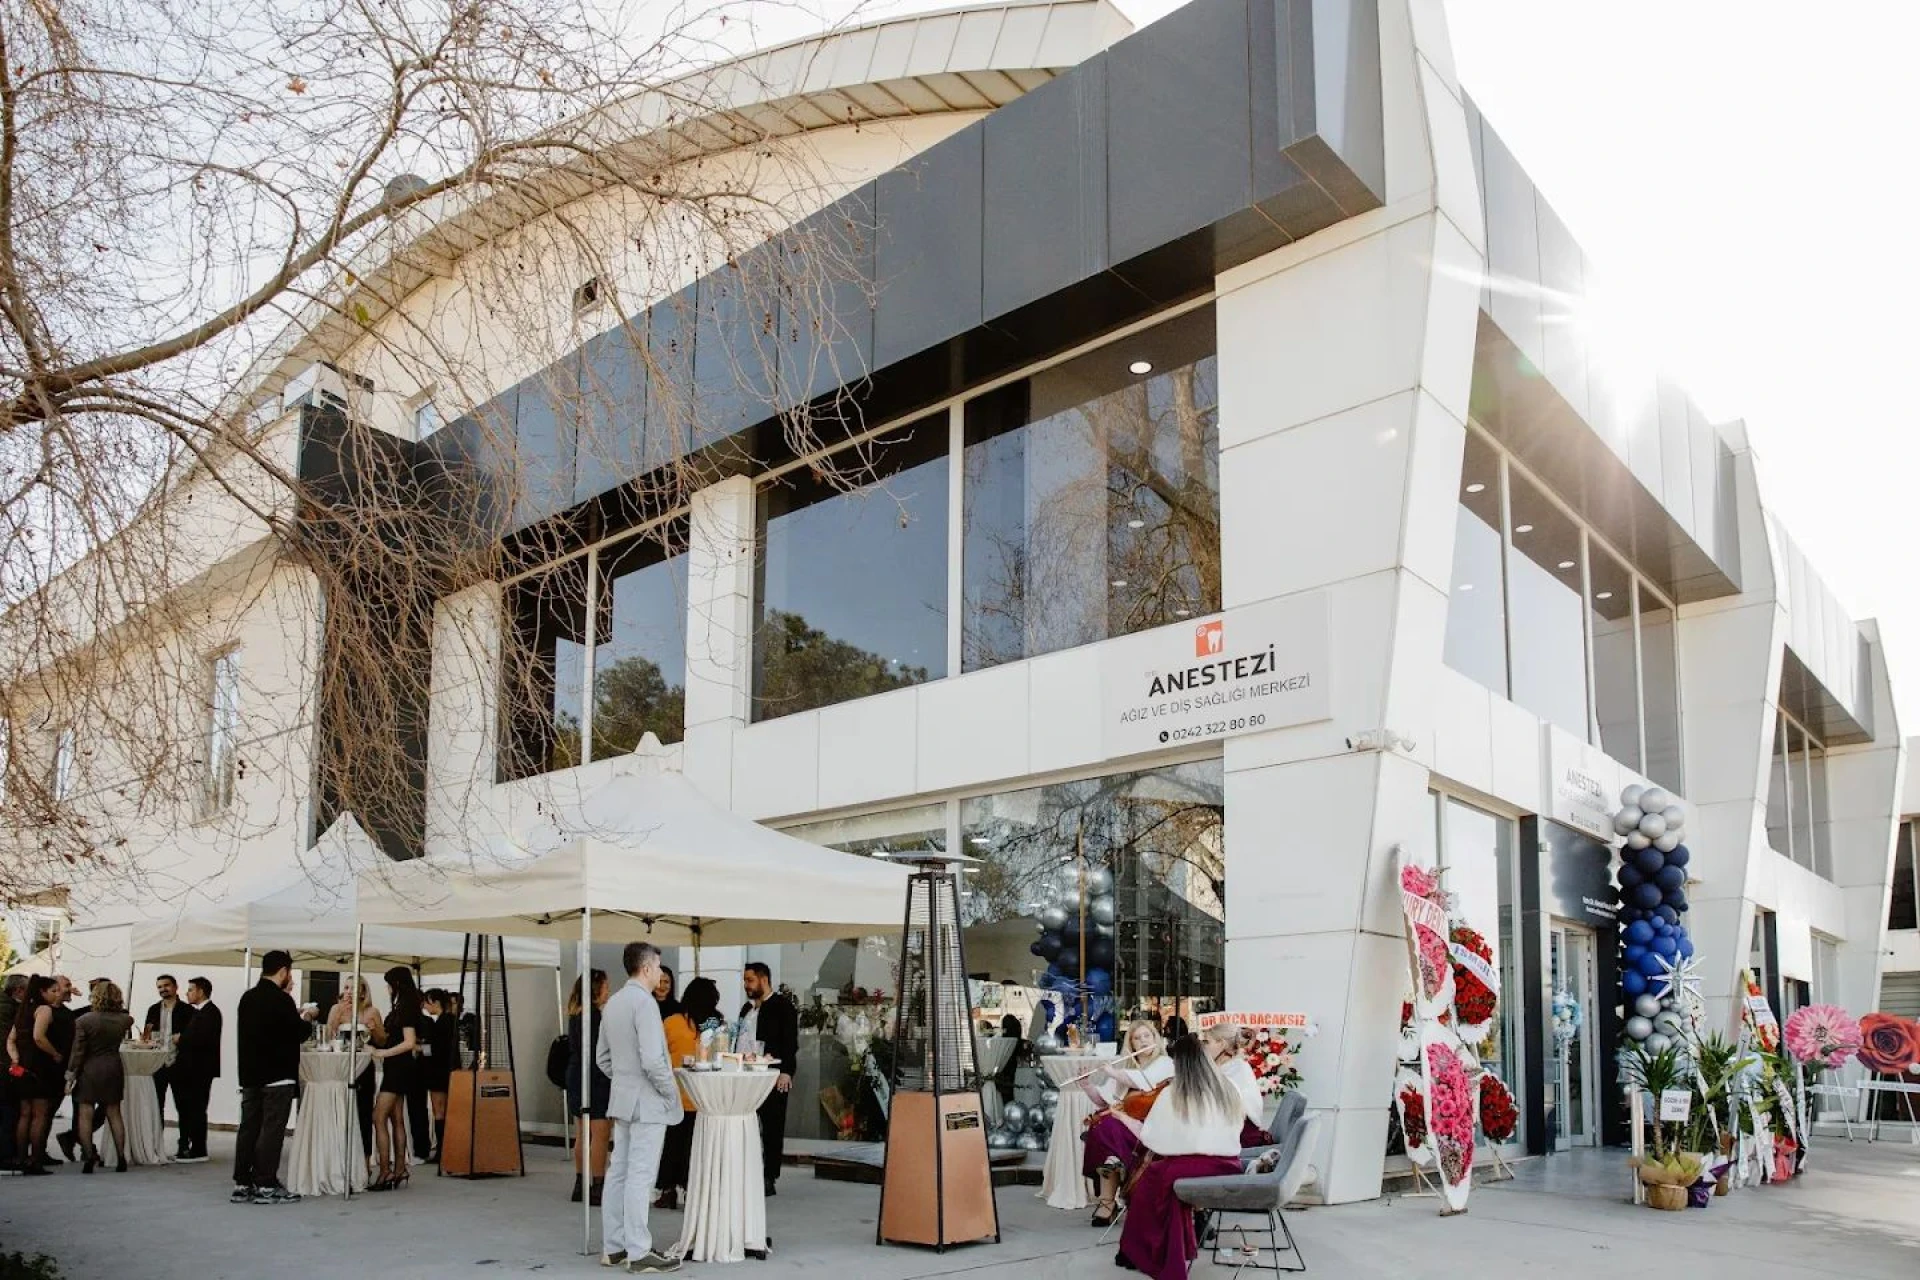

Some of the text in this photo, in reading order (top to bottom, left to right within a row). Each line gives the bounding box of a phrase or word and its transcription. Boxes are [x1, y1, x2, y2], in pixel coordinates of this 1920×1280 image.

[1149, 643, 1275, 698] ANESTEZİ
[1120, 707, 1149, 723] AĞIZ
[1151, 703, 1167, 717] VE
[1170, 697, 1191, 714] DİŞ
[1250, 671, 1310, 699] MERKEZİ
[1172, 714, 1266, 741] 0242 322 80 80
[1202, 1015, 1216, 1027] DR
